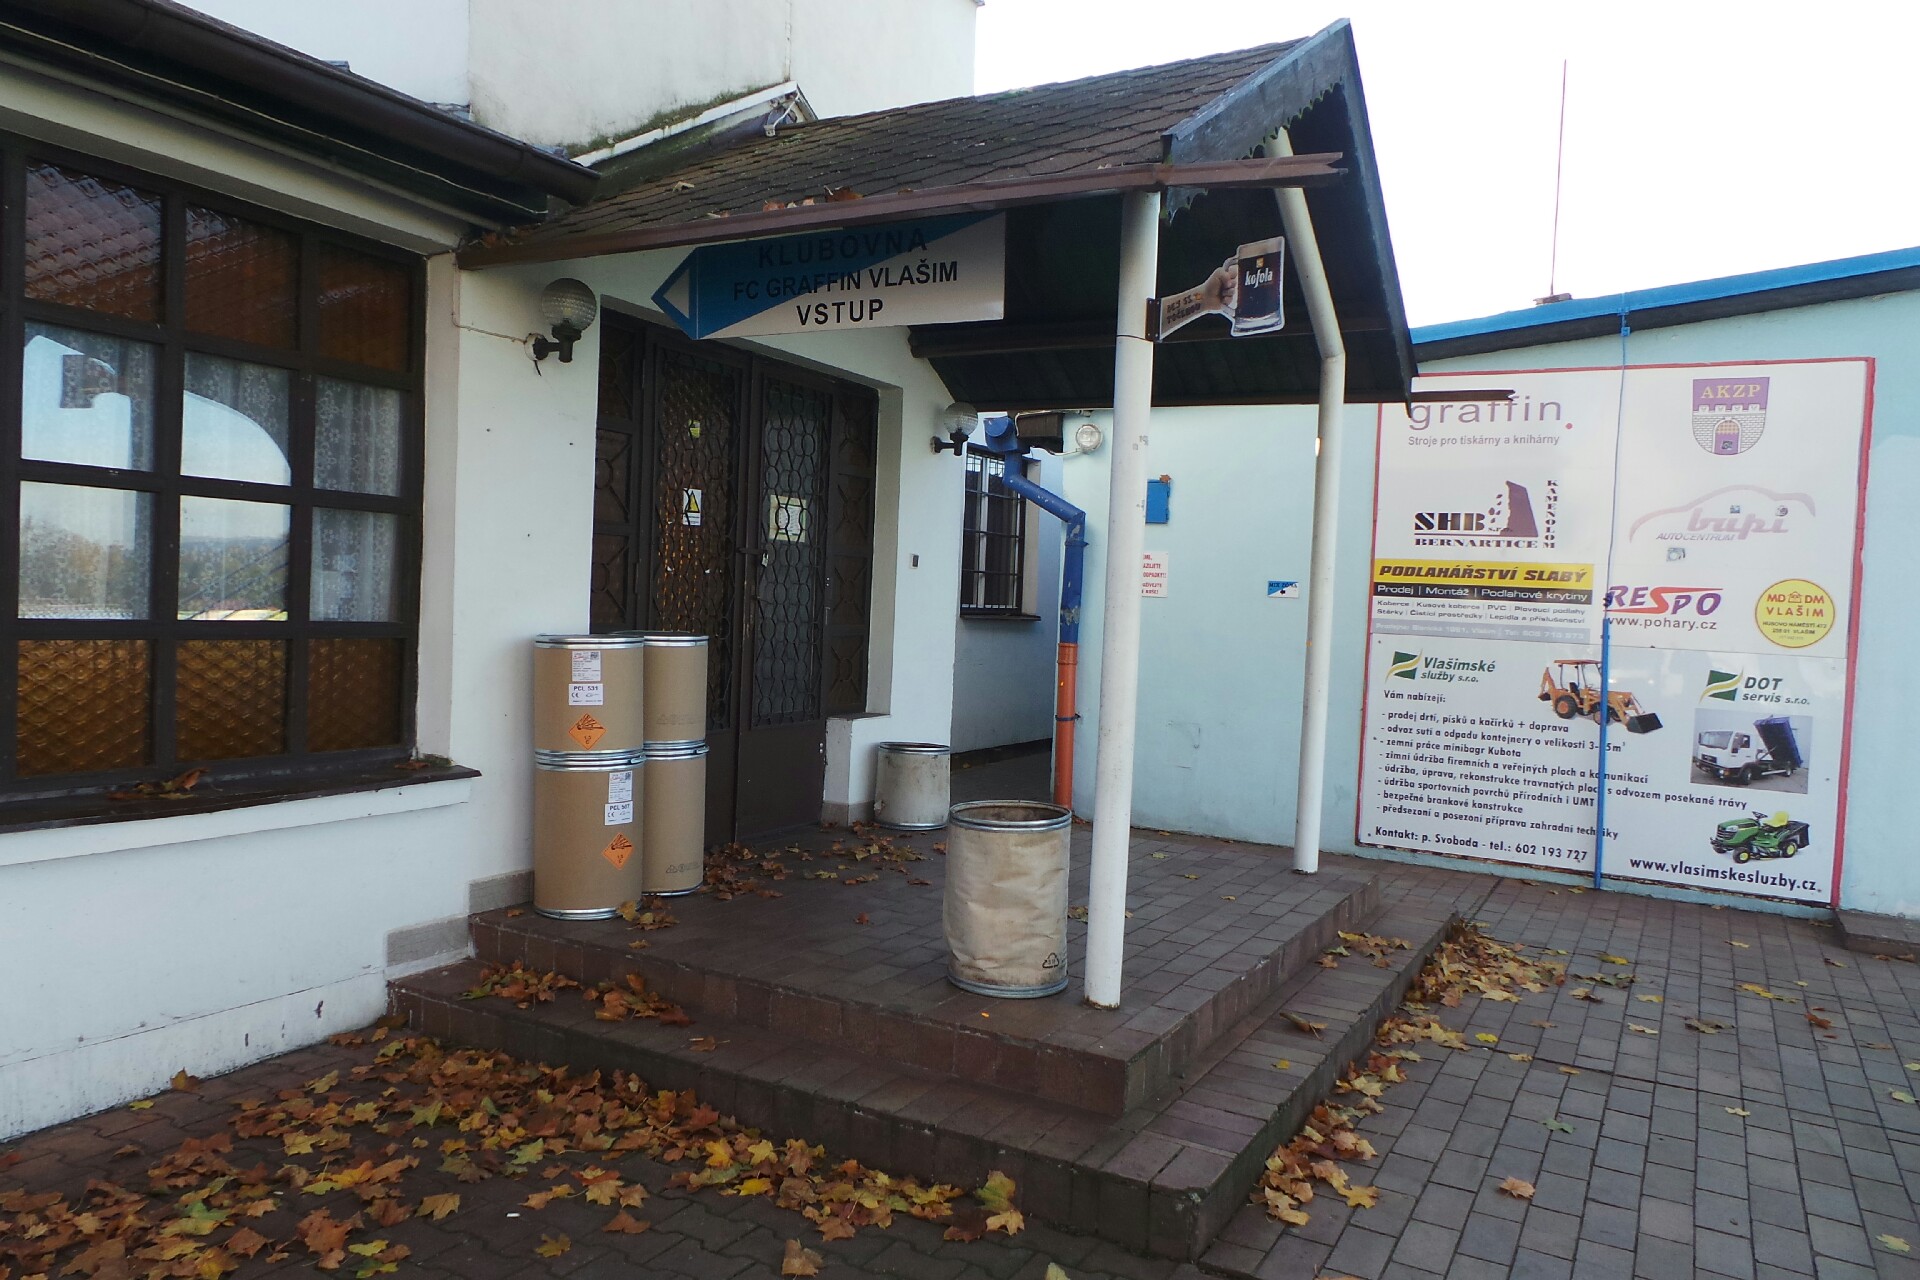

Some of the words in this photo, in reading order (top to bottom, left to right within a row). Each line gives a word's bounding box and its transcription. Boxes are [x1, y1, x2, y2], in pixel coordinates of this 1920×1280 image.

[759, 228, 927, 269] KLUBOVNA
[733, 280, 760, 301] FC
[766, 270, 861, 298] GRAFFIN
[868, 258, 959, 289] VLAŠIM
[1245, 268, 1273, 288] kofola
[796, 298, 884, 327] VSTUP
[1700, 384, 1761, 399] AKZP
[1408, 436, 1437, 447] Stroje
[1440, 437, 1458, 447] pro
[1460, 435, 1501, 446] tiskárny
[1513, 434, 1560, 446] knihárny
[1414, 512, 1485, 531] SHB
[1543, 480, 1558, 549] KAMENOLOM
[1415, 538, 1538, 549] BERNARTICE
[1656, 532, 1735, 541] AUTOCENTRUM
[1379, 564, 1518, 581] PODLAHÁŘSTVÍ
[1523, 568, 1588, 583] SLABÝ
[1377, 584, 1414, 595] Prodej
[1426, 587, 1469, 597] Montáž
[1481, 588, 1542, 599] Podlahové
[1546, 591, 1588, 601] krytiny
[1606, 585, 1724, 616] RESPO
[1766, 593, 1786, 603] MD
[1804, 594, 1825, 604] DM
[1766, 605, 1825, 618] VLAŠIM
[1423, 656, 1496, 673] Vlašimské
[1421, 671, 1455, 683] služby
[1458, 673, 1479, 683] s.r.o.
[1744, 676, 1783, 691] DOT
[1384, 690, 1404, 700] Vám
[1407, 693, 1447, 704] nabízejí:
[1742, 691, 1781, 703] servis
[1785, 696, 1811, 705] s.r.o.
[1388, 711, 1417, 723] prodej
[1419, 713, 1440, 723] drtí,
[1442, 714, 1467, 725] písků
[1478, 716, 1514, 728] kačírků
[1529, 721, 1569, 733] doprava
[1387, 725, 1413, 735] odvoz
[1416, 726, 1433, 736] sutí
[1444, 729, 1478, 741] odpadu
[1481, 732, 1532, 746] kontejnery
[1544, 737, 1586, 749] velikosti
[1387, 739, 1414, 748] zemní
[1416, 740, 1441, 752] práce
[1443, 742, 1485, 755] minibagr
[1488, 746, 1521, 757] Kubota
[1385, 751, 1411, 761] zimní
[1413, 752, 1444, 764] údržba
[1447, 755, 1490, 769] firemních
[1502, 759, 1548, 774] veřejných
[1551, 765, 1577, 779] ploch
[1384, 764, 1419, 775] údržba,
[1422, 767, 1457, 780] úprava,
[1459, 772, 1520, 785] rekonstrukce
[1523, 777, 1575, 791] travnatých
[1578, 783, 1599, 793] ploc
[1616, 787, 1661, 799] odvozem
[1664, 791, 1715, 805] posekané
[1718, 797, 1747, 810] trávy
[1384, 777, 1415, 788] údržba
[1418, 780, 1470, 794] sportovních
[1473, 787, 1509, 800] povrchů
[1513, 790, 1563, 804] přírodních
[1573, 797, 1595, 807] UMT
[1383, 790, 1424, 803] bezpečné
[1427, 794, 1469, 808] brankové
[1472, 800, 1523, 813] konstrukce
[1382, 804, 1431, 818] předsezoní
[1434, 810, 1440, 818] a
[1442, 810, 1483, 824] posezoní
[1485, 815, 1527, 829] příprava
[1529, 820, 1574, 834] zahradní
[1577, 826, 1618, 840] techiky
[1375, 826, 1419, 841] Kontakt:
[1422, 835, 1431, 843] p.
[1435, 834, 1479, 848] Svoboda
[1489, 840, 1511, 852] tel.:
[1515, 844, 1536, 855] 602
[1541, 846, 1562, 858] 193
[1566, 848, 1588, 861] 727
[1630, 858, 1817, 891] www.vlasimskesluzby.cz
